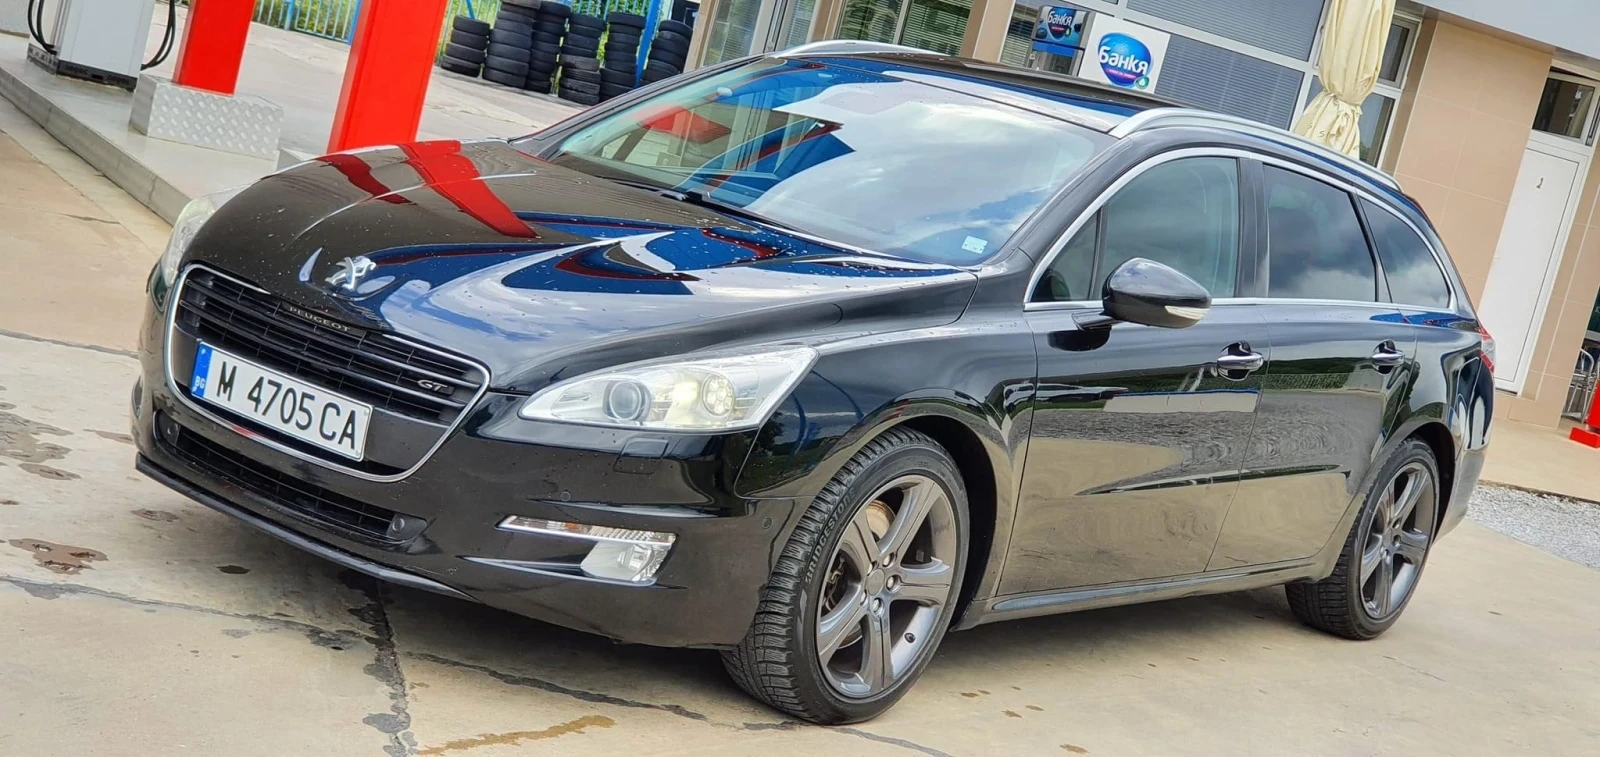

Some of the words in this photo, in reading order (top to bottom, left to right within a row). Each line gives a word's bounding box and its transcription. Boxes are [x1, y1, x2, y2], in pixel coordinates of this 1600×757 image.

[289, 306, 350, 332] PEUGEOT
[195, 375, 206, 389] BG
[417, 379, 448, 392] GT
[216, 360, 237, 402] M
[247, 375, 316, 431] 4705
[319, 402, 356, 450] CA
[804, 487, 856, 584] BRIDGESTONE
